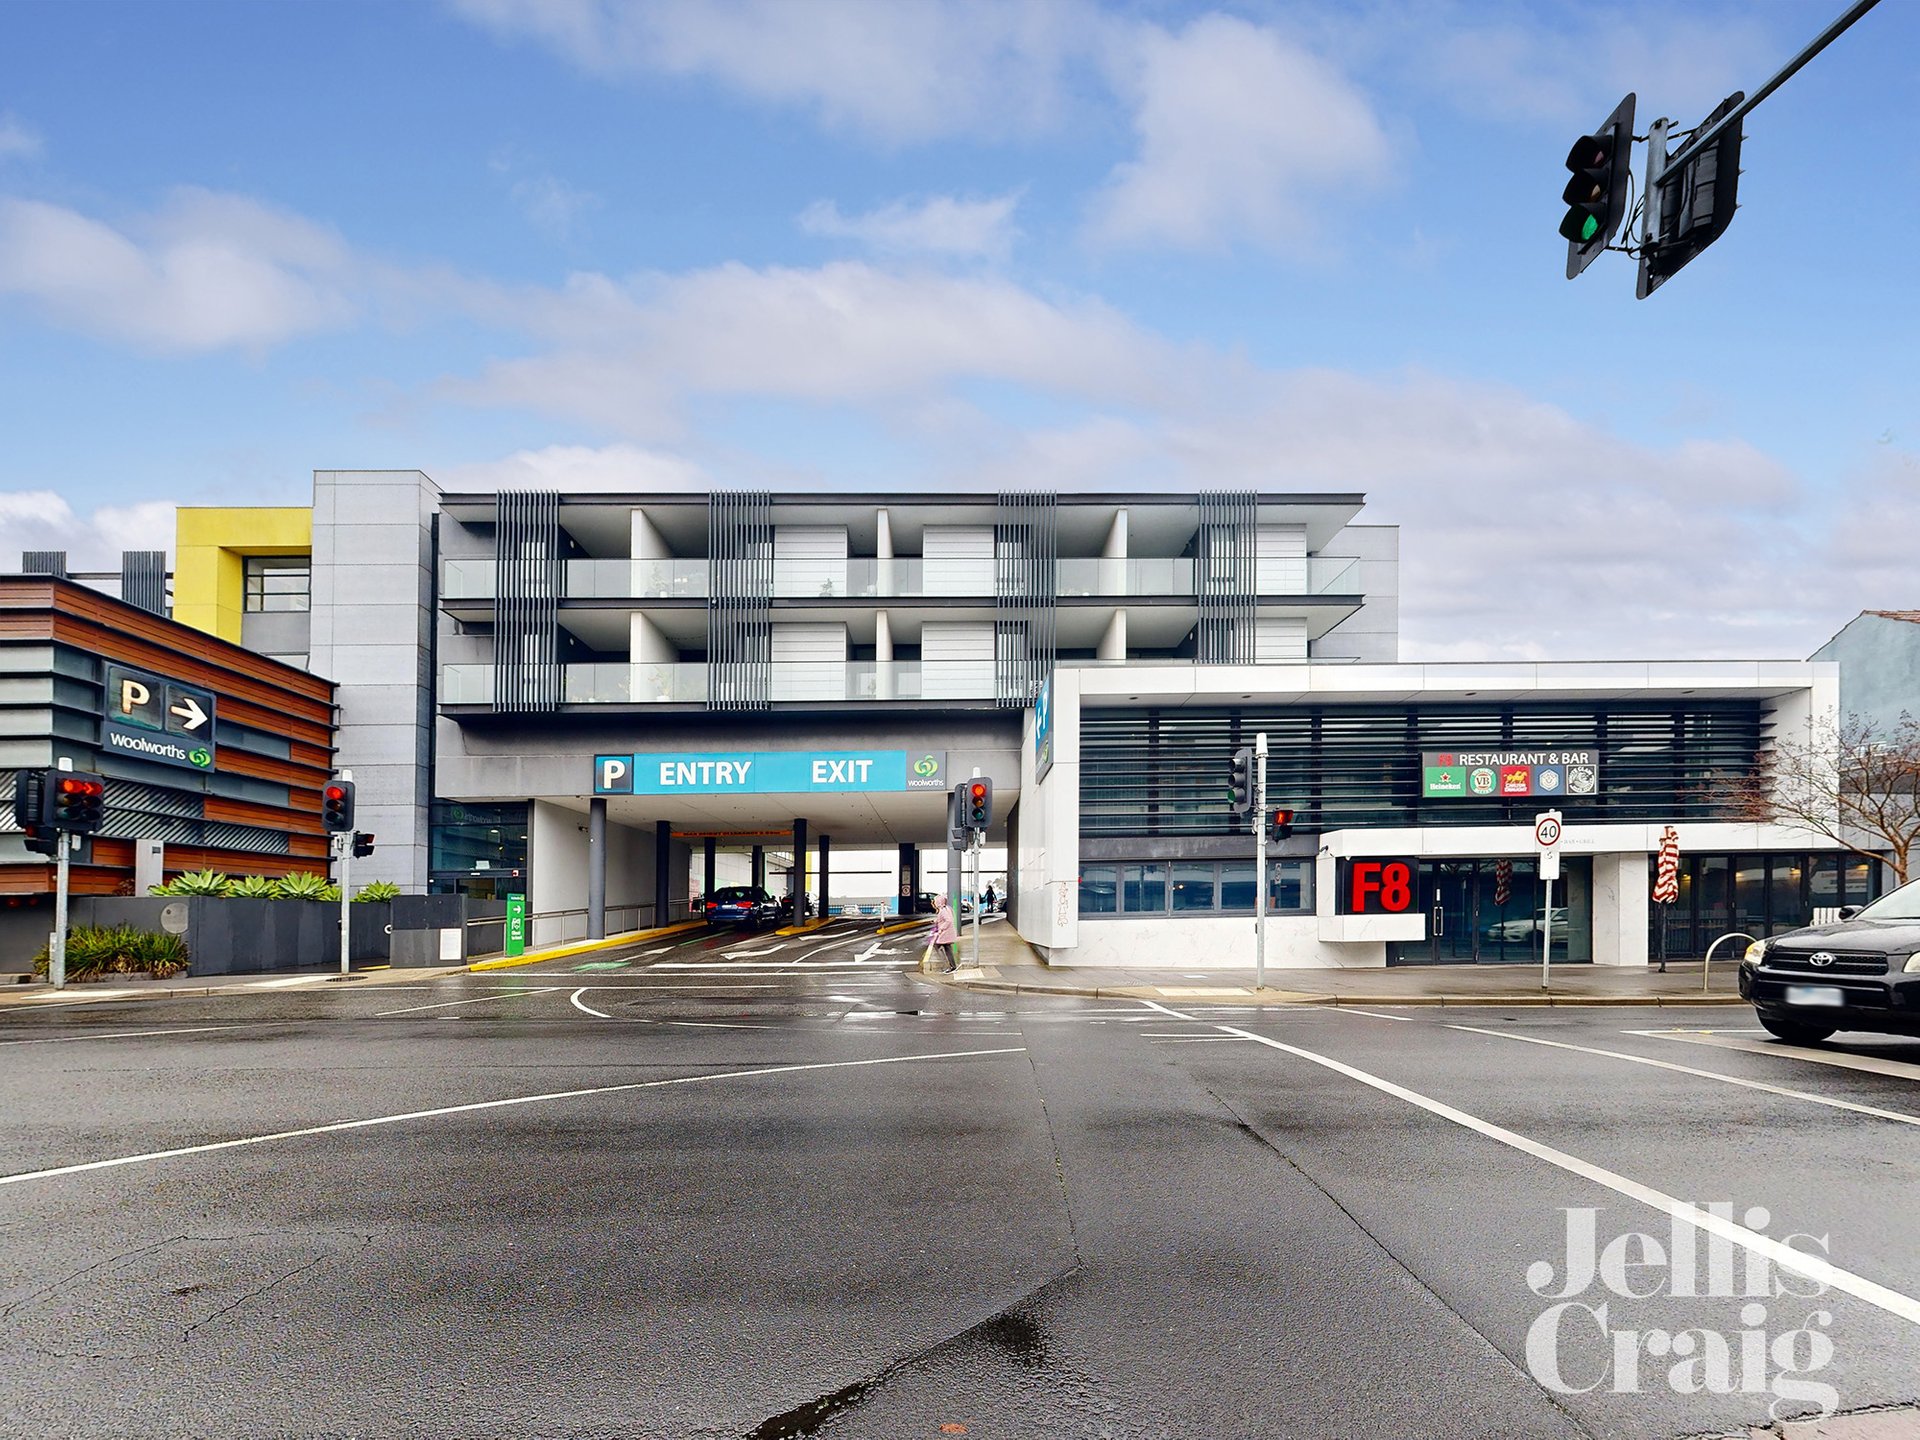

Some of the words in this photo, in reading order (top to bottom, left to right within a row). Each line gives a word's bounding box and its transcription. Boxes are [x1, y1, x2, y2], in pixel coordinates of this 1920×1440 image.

[122, 679, 150, 714] P
[110, 732, 186, 760] Woolworths
[1459, 753, 1546, 766] RESTAURANT
[1548, 753, 1558, 765] &
[1562, 752, 1589, 765] BAR
[603, 760, 625, 789] P
[660, 761, 751, 785] ENTRY
[812, 760, 873, 783] EXIT
[1476, 777, 1490, 785] VB
[1540, 826, 1557, 838] 40
[1352, 863, 1411, 912] F8
